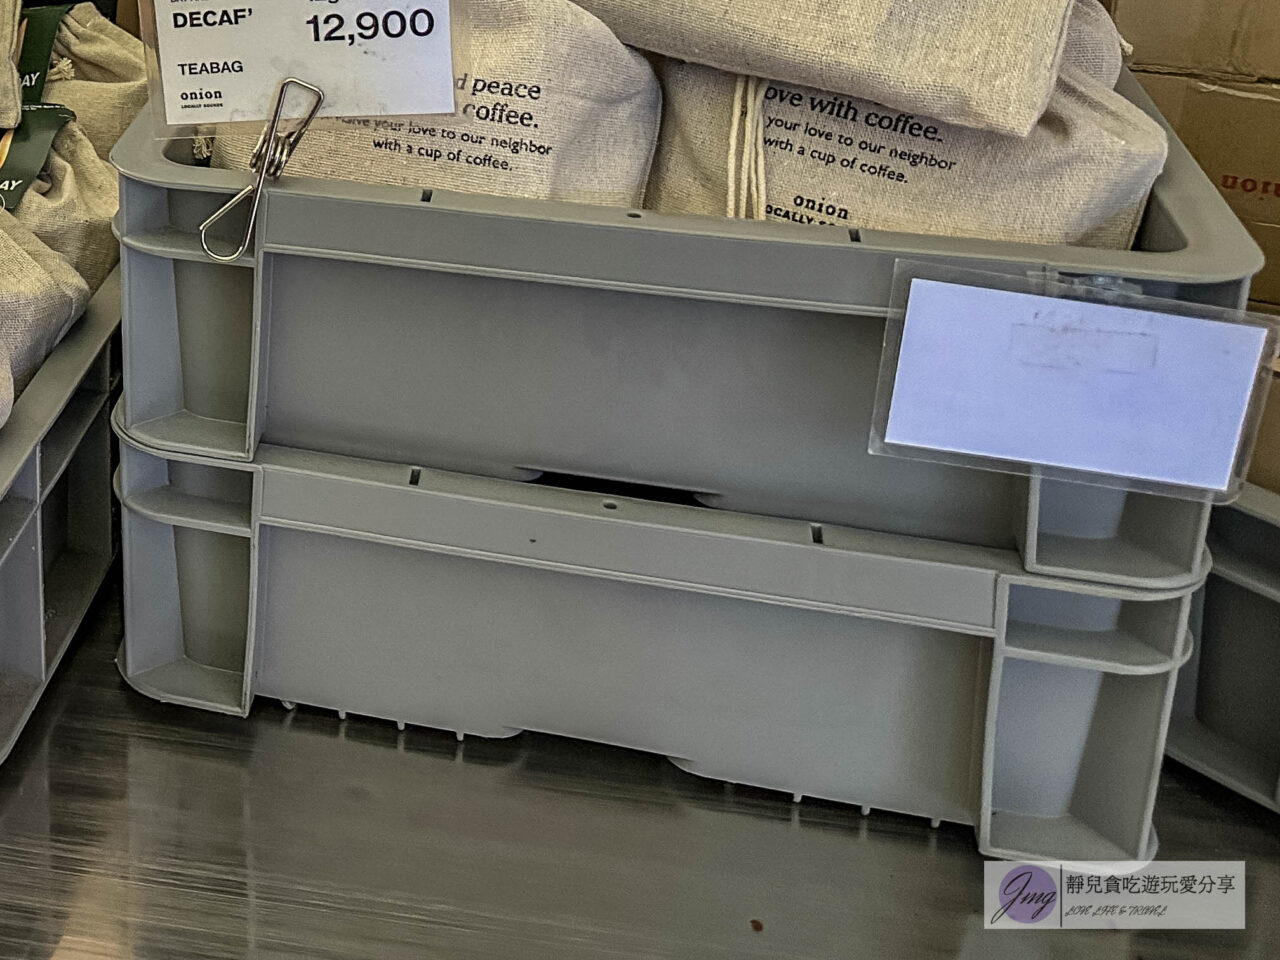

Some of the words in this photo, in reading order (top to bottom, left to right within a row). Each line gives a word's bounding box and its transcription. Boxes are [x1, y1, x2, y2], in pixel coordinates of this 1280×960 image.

[172, 8, 253, 29] DECAF'
[305, 8, 435, 46] 12,900
[178, 61, 244, 76] TEABAG
[180, 88, 223, 101] onion
[472, 78, 542, 100] peace
[809, 96, 858, 123] with
[864, 110, 943, 142] coffee.
[408, 121, 437, 136] love
[441, 128, 455, 140] to
[461, 133, 486, 144] our
[490, 136, 553, 156] neighbor
[766, 115, 800, 132] your
[804, 122, 834, 141] love
[837, 133, 854, 147] to
[858, 139, 887, 155] our
[889, 147, 958, 171] neighbor
[372, 139, 401, 153] with
[417, 146, 442, 162] cup
[447, 150, 462, 163] of
[465, 154, 513, 172] coffee.
[763, 136, 794, 152] with
[810, 148, 836, 167] cup
[840, 155, 857, 170] of
[860, 162, 908, 184] coffee.
[793, 194, 850, 220] onion
